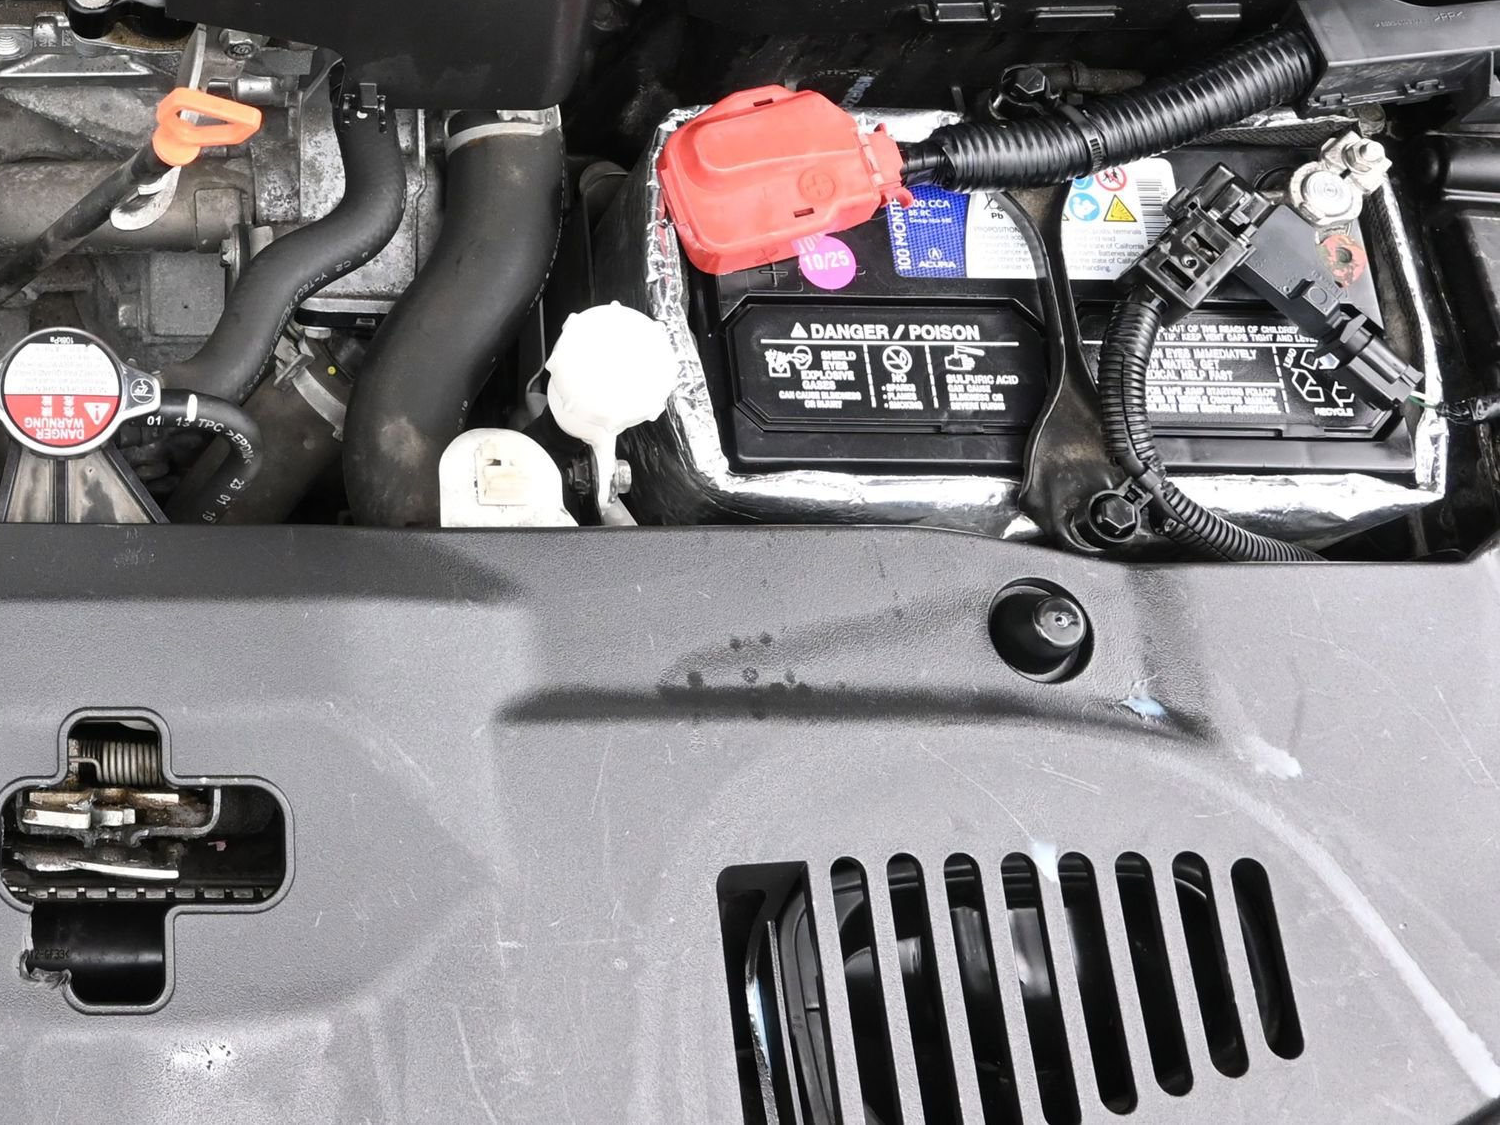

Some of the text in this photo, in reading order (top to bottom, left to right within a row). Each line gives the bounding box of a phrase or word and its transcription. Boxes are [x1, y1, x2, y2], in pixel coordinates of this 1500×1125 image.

[928, 199, 951, 209] CCA
[889, 198, 912, 270] 100 MONTH
[802, 250, 849, 272] 10/25
[918, 260, 957, 269] ACURA
[810, 324, 980, 342] DANGER / POISON
[1187, 325, 1200, 333] OF
[1201, 325, 1217, 333] THE
[1248, 325, 1259, 333] OF
[1182, 333, 1201, 341] KEEP
[1205, 333, 1225, 341] VENT
[1227, 334, 1249, 342] CAPS
[1250, 334, 1273, 342] TIGHT
[1276, 334, 1293, 342] AND
[820, 350, 857, 361] SHIELD
[1165, 348, 1191, 358] EYES
[1193, 348, 1256, 360] IMMEDIATELY
[1283, 348, 1297, 368] LEAD
[822, 360, 849, 370] EYES
[1200, 360, 1220, 370] GET
[801, 370, 855, 381] EXPLOSIVE
[891, 373, 907, 383] NO
[946, 374, 1019, 385] SULFURIC ACID
[1180, 370, 1206, 381] HELP
[1208, 370, 1233, 381] FAST
[802, 380, 836, 390] GASES
[948, 384, 965, 393] CAN
[779, 391, 795, 399] CAN
[796, 391, 820, 399] CAUSE
[992, 393, 1004, 402] OR
[804, 400, 816, 408] OR
[1314, 407, 1354, 417] RECYCLE
[25, 417, 84, 429] WARNUNG
[147, 416, 161, 426] 01
[198, 418, 224, 432] TPC
[36, 429, 84, 440] DANGER
[229, 478, 244, 490] 23
